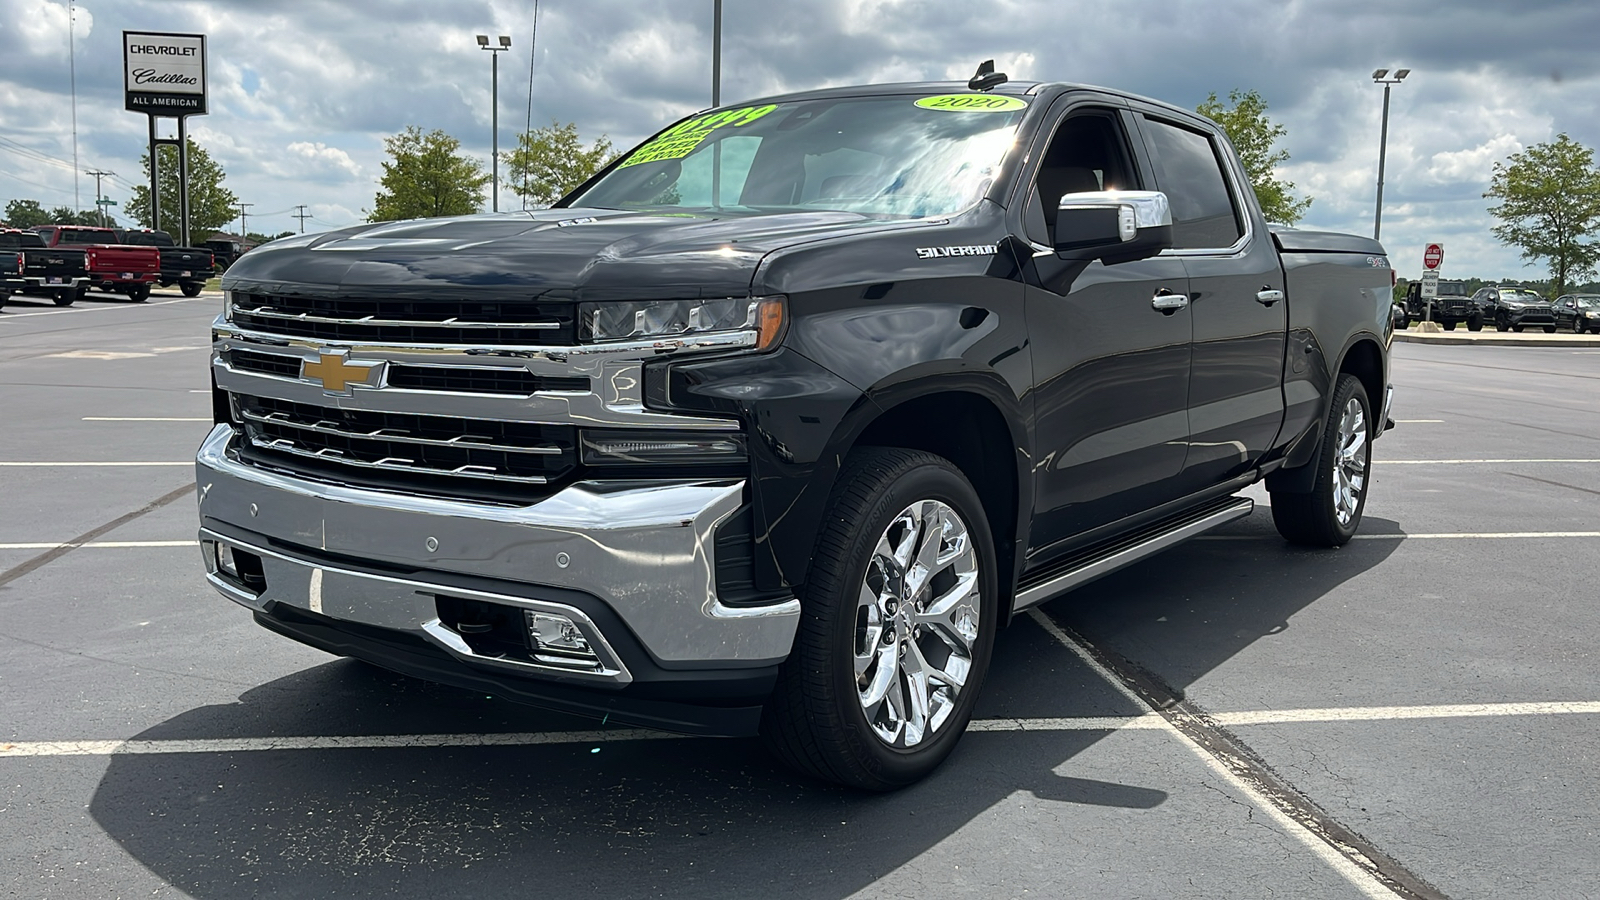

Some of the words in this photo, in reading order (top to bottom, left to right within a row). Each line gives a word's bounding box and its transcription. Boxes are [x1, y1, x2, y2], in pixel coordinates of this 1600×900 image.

[130, 44, 197, 56] CHEVROLET
[132, 68, 197, 85] Cadillac
[133, 97, 149, 105] ALL
[152, 97, 198, 107] AMERICAN
[930, 97, 1009, 109] 2020
[916, 244, 998, 259] SILVERADO
